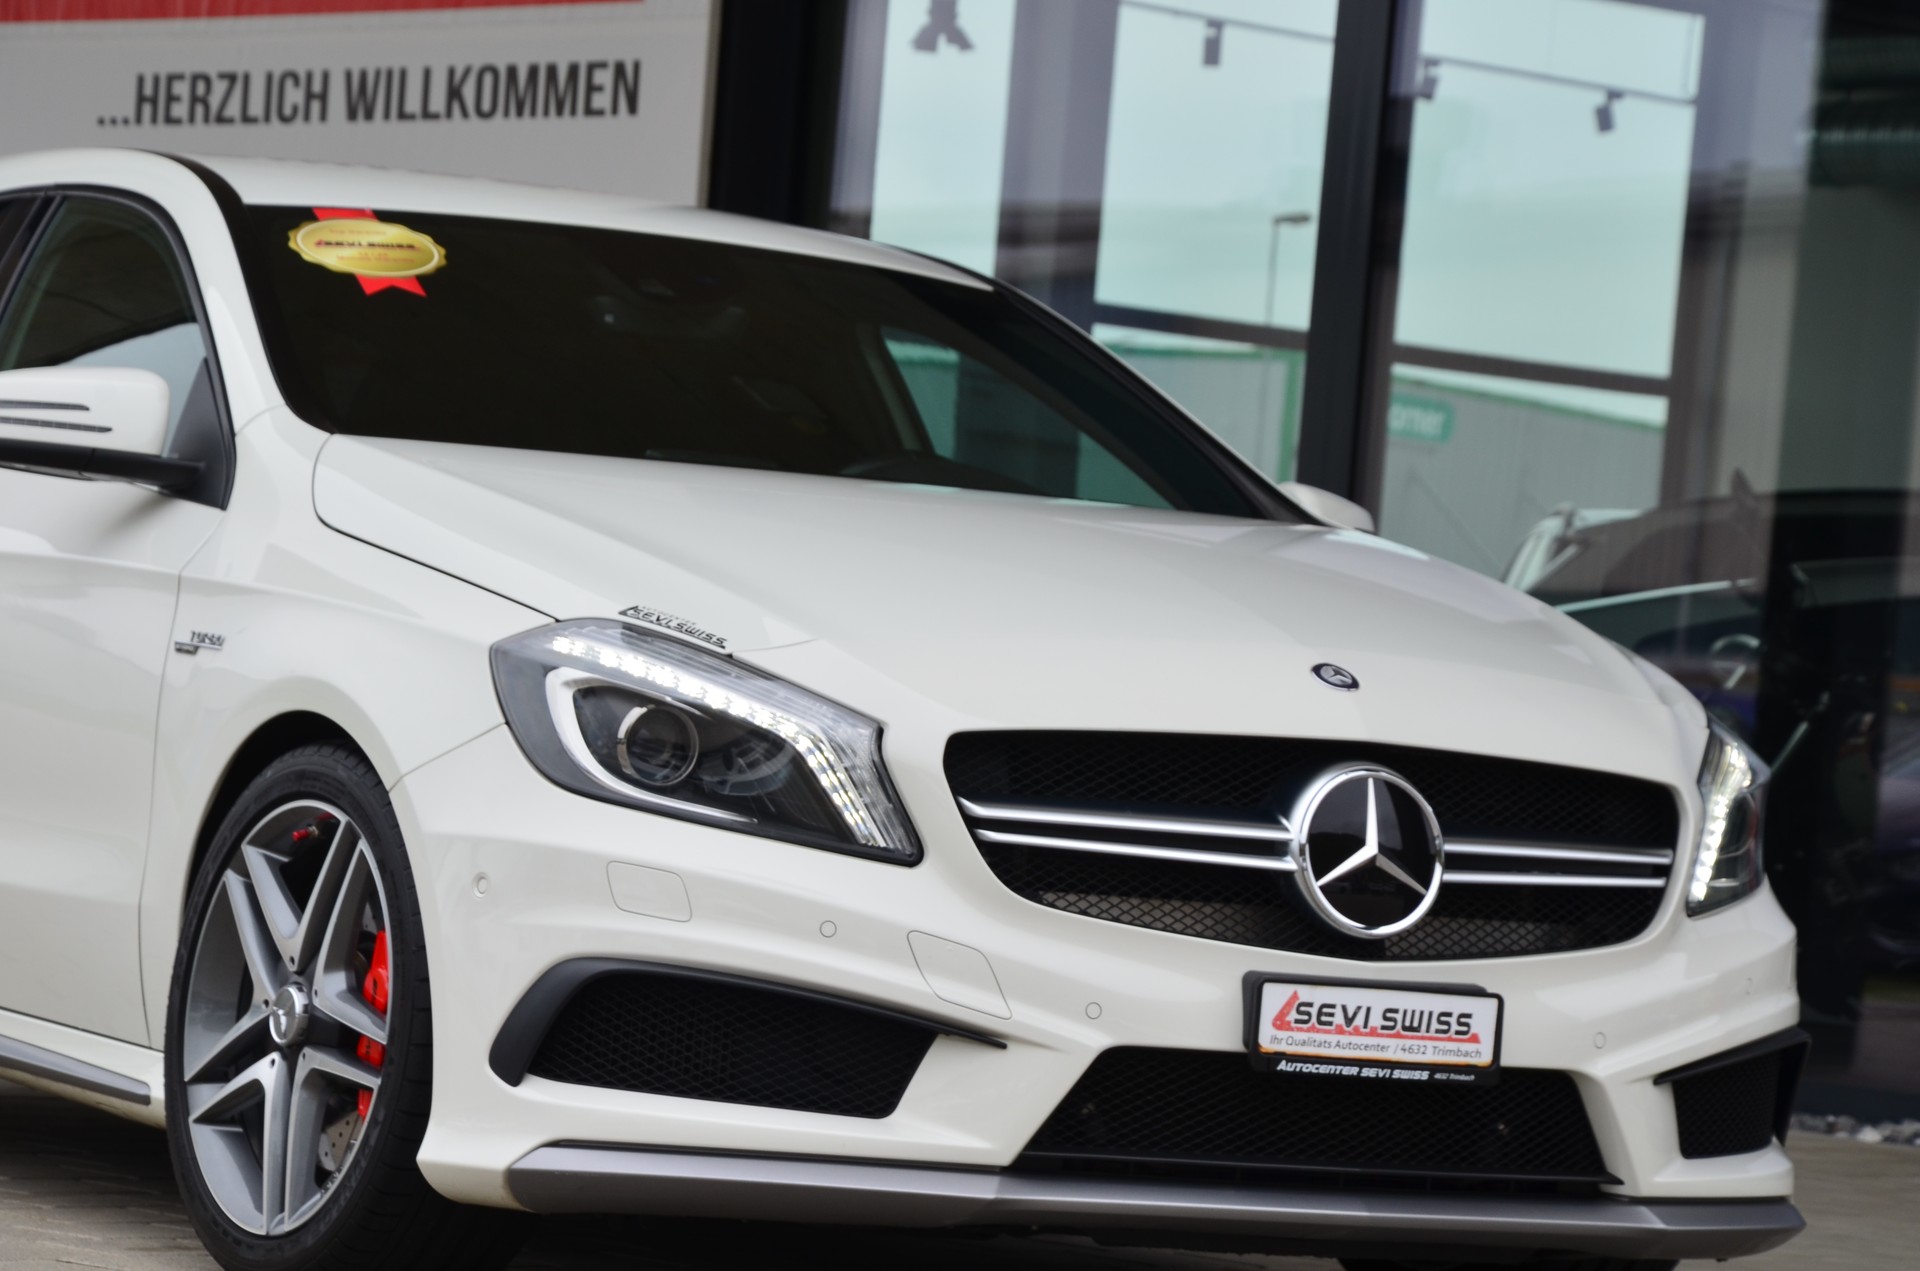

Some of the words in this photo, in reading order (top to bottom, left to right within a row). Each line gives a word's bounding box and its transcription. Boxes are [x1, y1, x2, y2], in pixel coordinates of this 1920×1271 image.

[344, 58, 640, 122] WILLKOMMEN
[629, 607, 673, 626] SEVI
[674, 622, 728, 646] SWISS
[1293, 1001, 1371, 1030] SEVI
[1379, 1008, 1473, 1036] SWISS
[1269, 1034, 1284, 1046] Ihr
[1334, 1039, 1390, 1053] Autocenter
[1400, 1043, 1428, 1056] 4632
[1431, 1045, 1482, 1059] Trimbach
[1360, 1067, 1391, 1079] SEVI
[1391, 1069, 1430, 1081] SWISS
